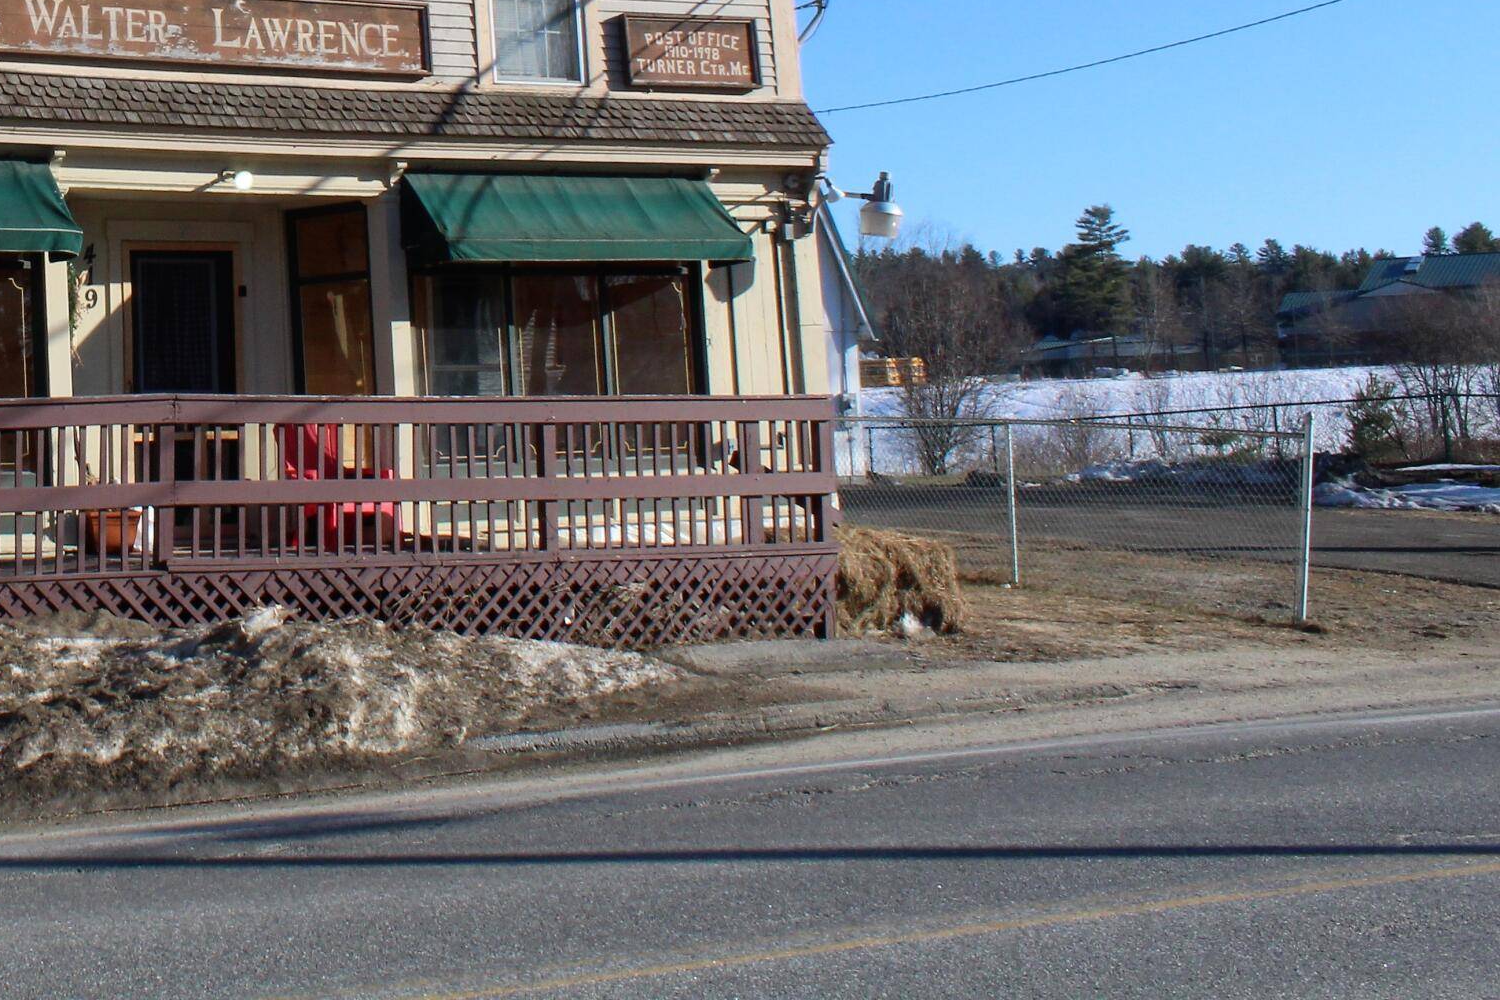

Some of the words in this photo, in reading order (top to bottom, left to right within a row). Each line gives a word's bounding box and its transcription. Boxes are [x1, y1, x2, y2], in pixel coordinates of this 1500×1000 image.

[644, 30, 683, 45] POST
[688, 31, 740, 50] OFFICE
[665, 46, 719, 60] 1910-1998
[637, 58, 695, 74] TURNER
